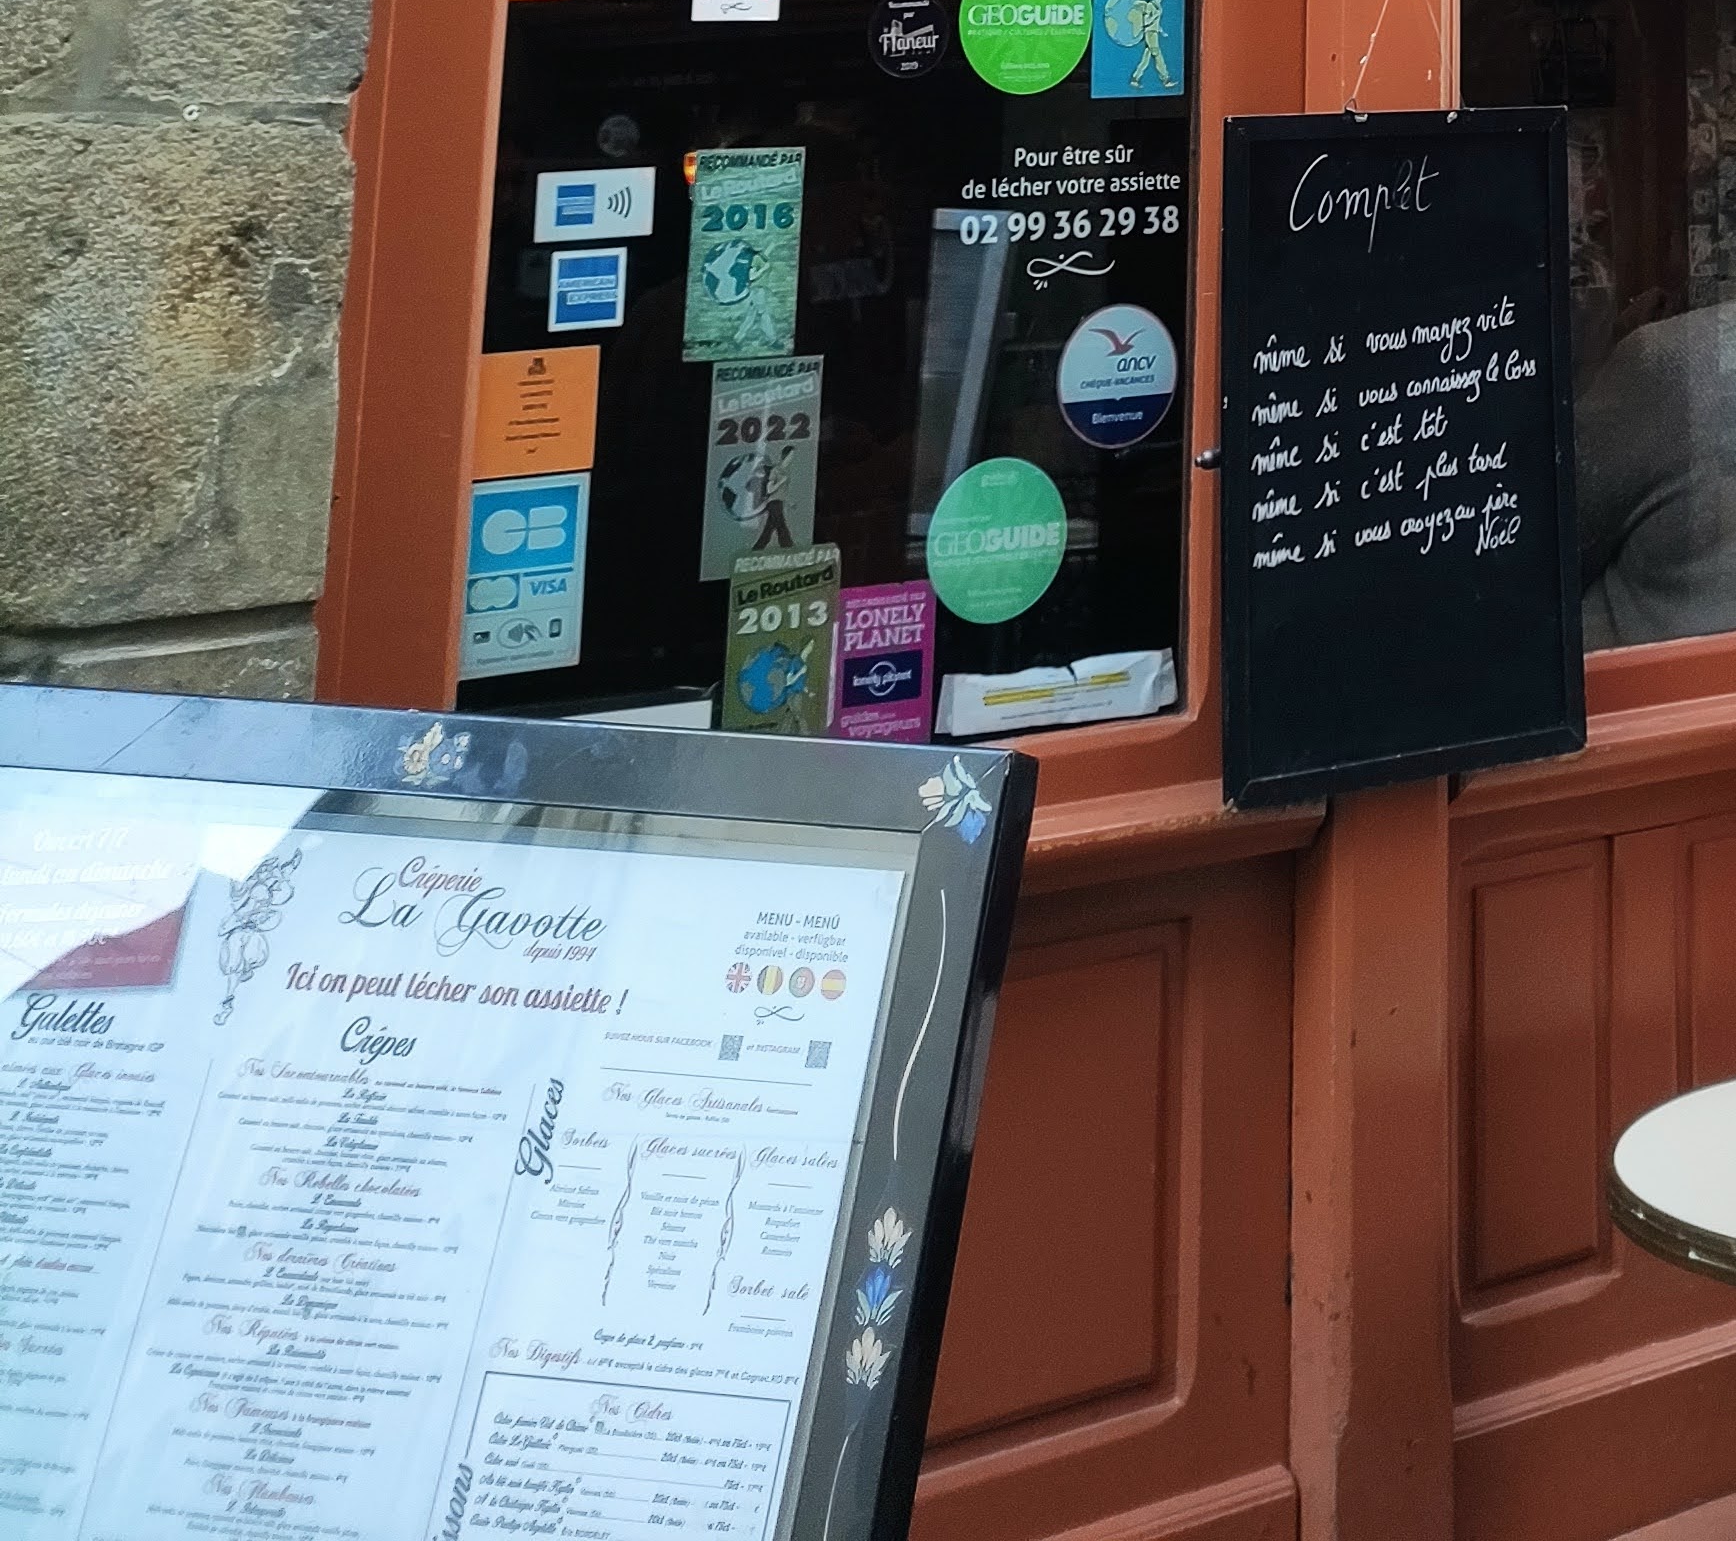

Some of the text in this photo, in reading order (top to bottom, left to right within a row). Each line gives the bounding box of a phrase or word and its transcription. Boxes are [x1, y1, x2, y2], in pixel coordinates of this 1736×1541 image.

[1014, 145, 1134, 168] Pour être sûr
[962, 172, 1180, 199] de lécher votre assiette
[701, 202, 794, 231] 2016
[960, 205, 1179, 245] 02 99 36 29 38
[1253, 334, 1310, 374] même
[1323, 335, 1346, 364] si
[1366, 330, 1407, 353] vous
[1476, 295, 1515, 332] vite
[1252, 392, 1303, 426] même
[1315, 388, 1338, 417] si
[1359, 382, 1398, 408] vous
[1407, 369, 1481, 402] connaissez
[1486, 352, 1499, 382] le
[716, 412, 810, 445] 2022
[1251, 436, 1302, 475] même
[1315, 431, 1340, 463] si
[1361, 413, 1403, 451] c'est
[1252, 441, 1507, 522] même si c'est plus tard
[1253, 532, 1305, 568] même
[1315, 530, 1336, 559] si
[1355, 520, 1391, 547] vous
[1454, 503, 1475, 520] au
[1481, 483, 1518, 530] père
[1475, 516, 1521, 556] Noël
[529, 578, 567, 596] VISA
[736, 600, 828, 634] 2013
[845, 603, 926, 631] LONELY
[844, 623, 925, 651] PLANET
[338, 867, 607, 957] La Gavotte
[756, 911, 840, 929] MENU MENÚ
[744, 929, 788, 943] available
[564, 944, 598, 962] 1994
[796, 948, 848, 963] disponible
[286, 962, 319, 991] Ici
[319, 975, 347, 994] on
[347, 971, 404, 1003] peut
[406, 971, 476, 1004] lécher
[479, 983, 519, 1007] son
[524, 985, 612, 1015] assiette
[11, 992, 115, 1040] Galettes
[638, 1088, 683, 1110] Glaces
[514, 1078, 565, 1185] Glaces
